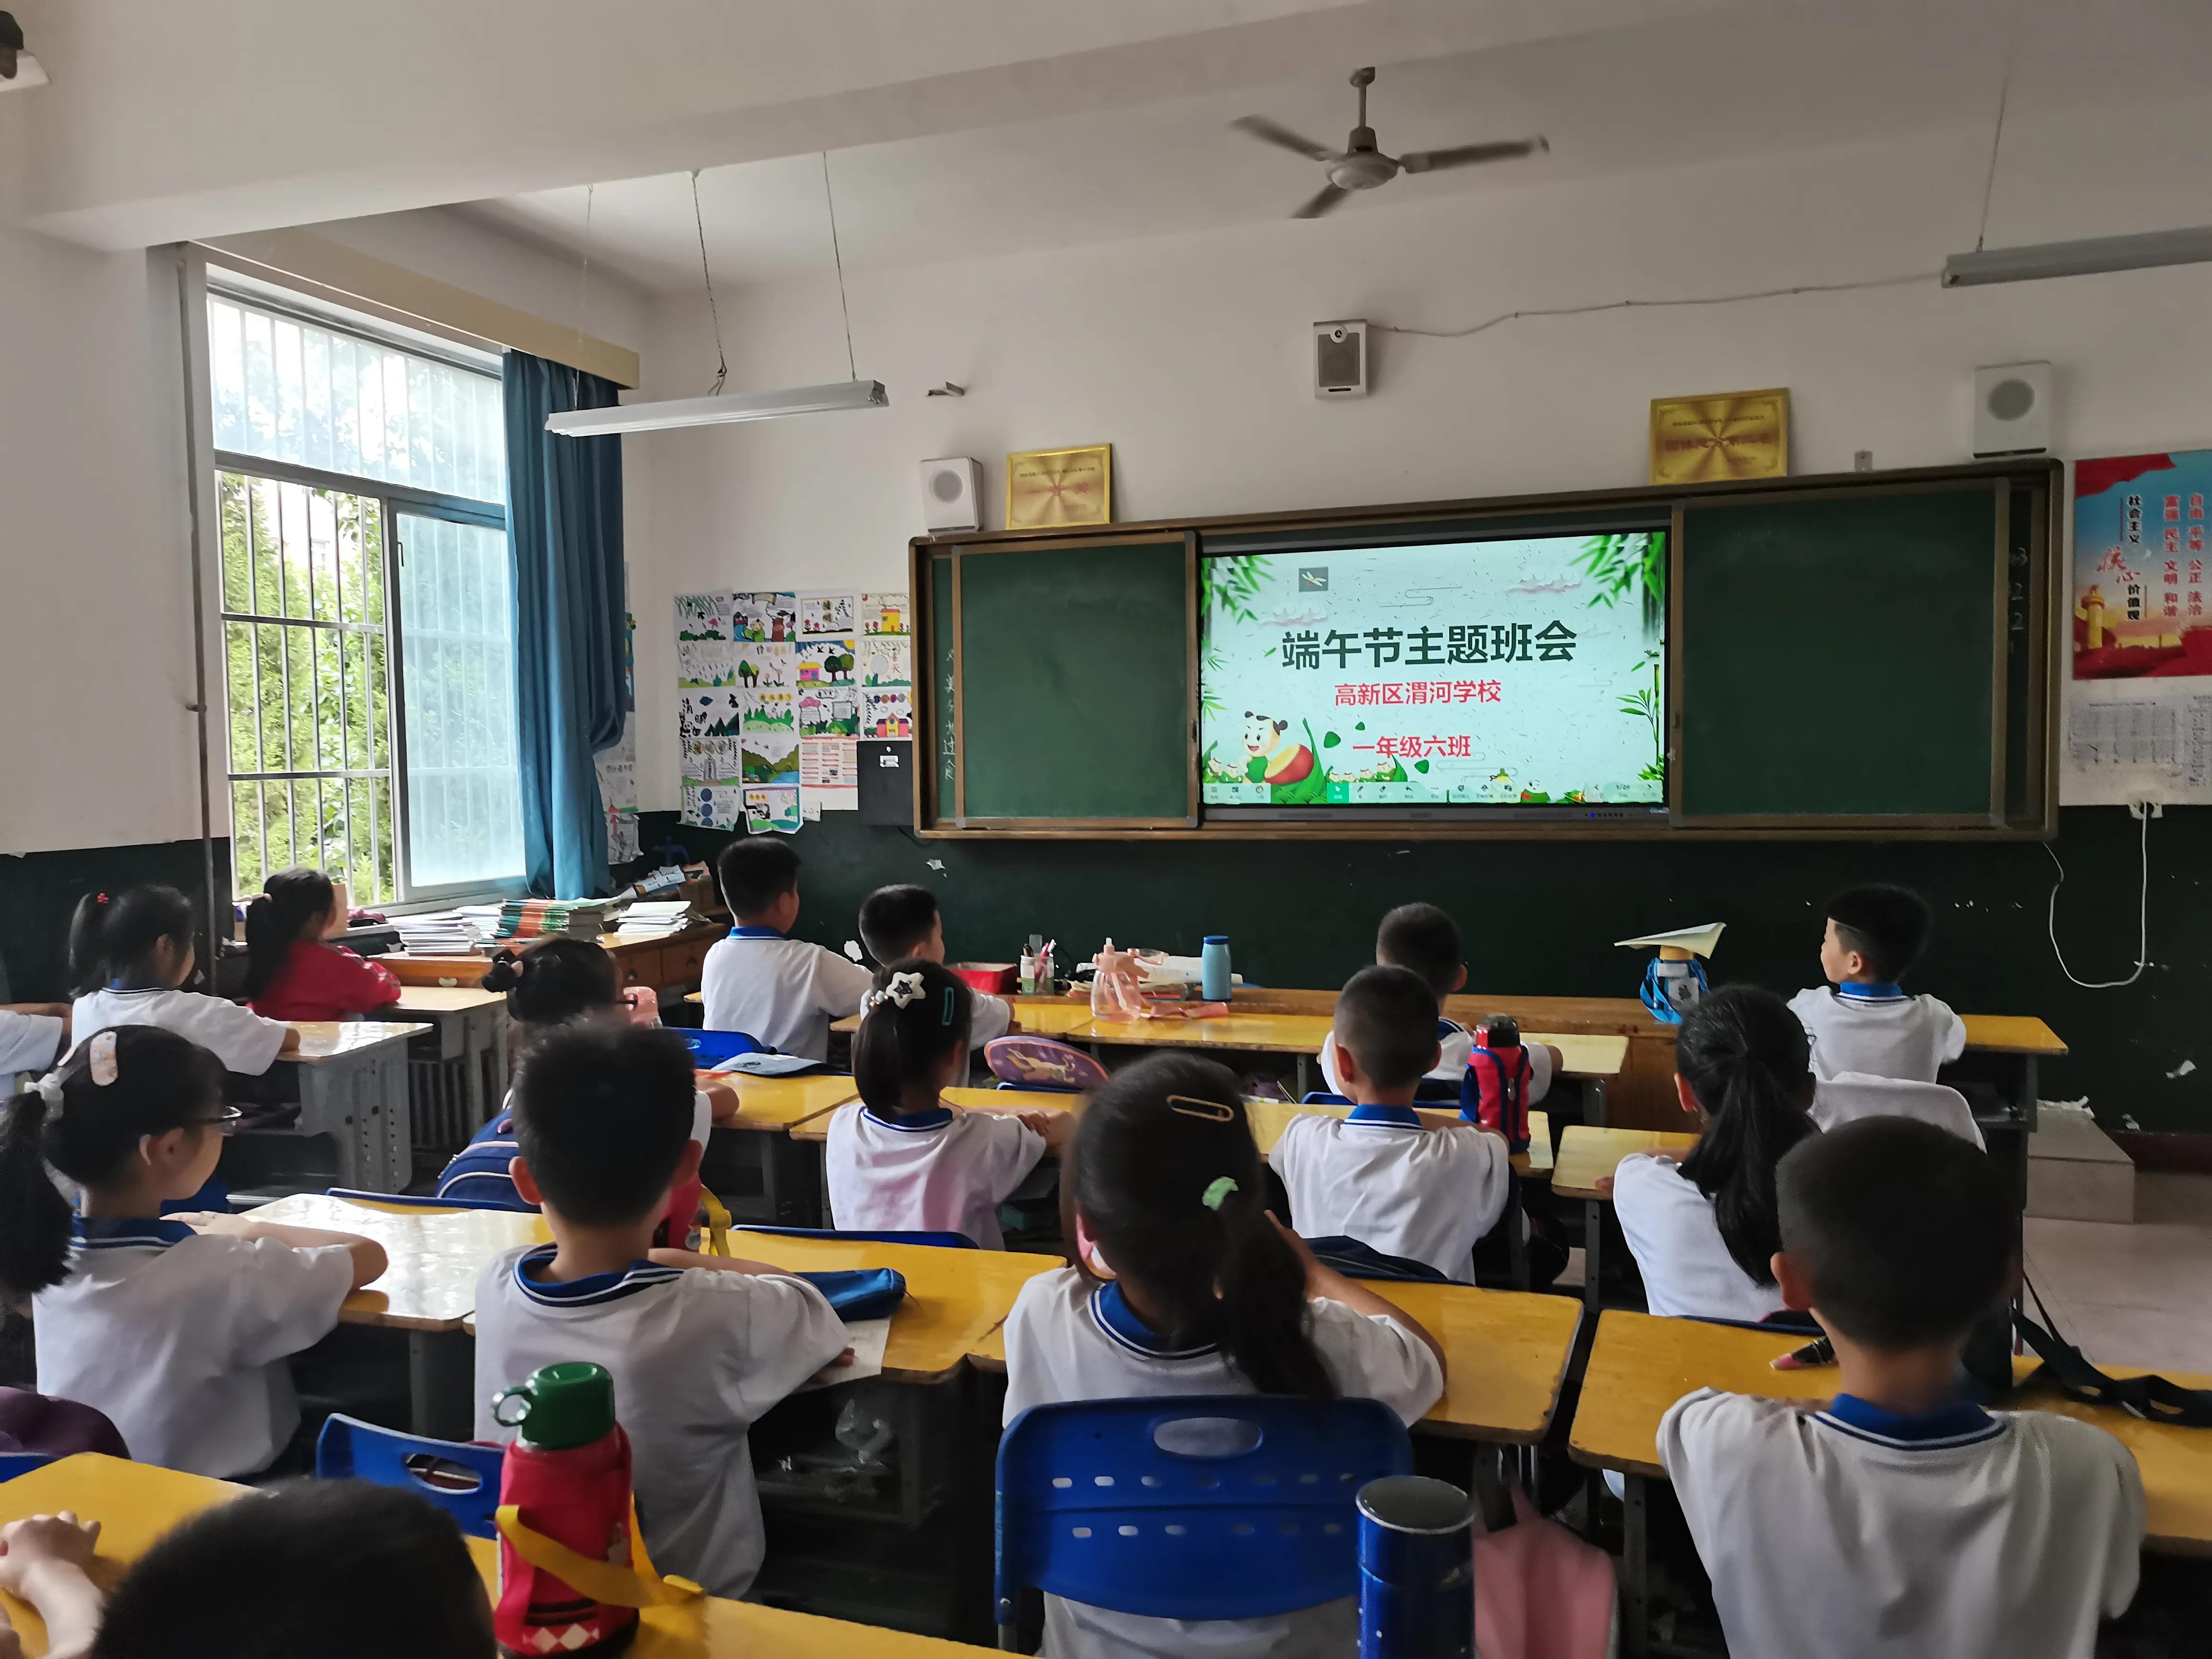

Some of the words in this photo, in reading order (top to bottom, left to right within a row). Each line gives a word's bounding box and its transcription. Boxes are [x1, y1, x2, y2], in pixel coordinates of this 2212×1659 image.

[2128, 495, 2142, 543] 社会主义
[1282, 619, 1577, 670] 端午节主题班会
[1334, 680, 1502, 706] 高新区渭河学校
[1353, 735, 1471, 758] 一年级六班
